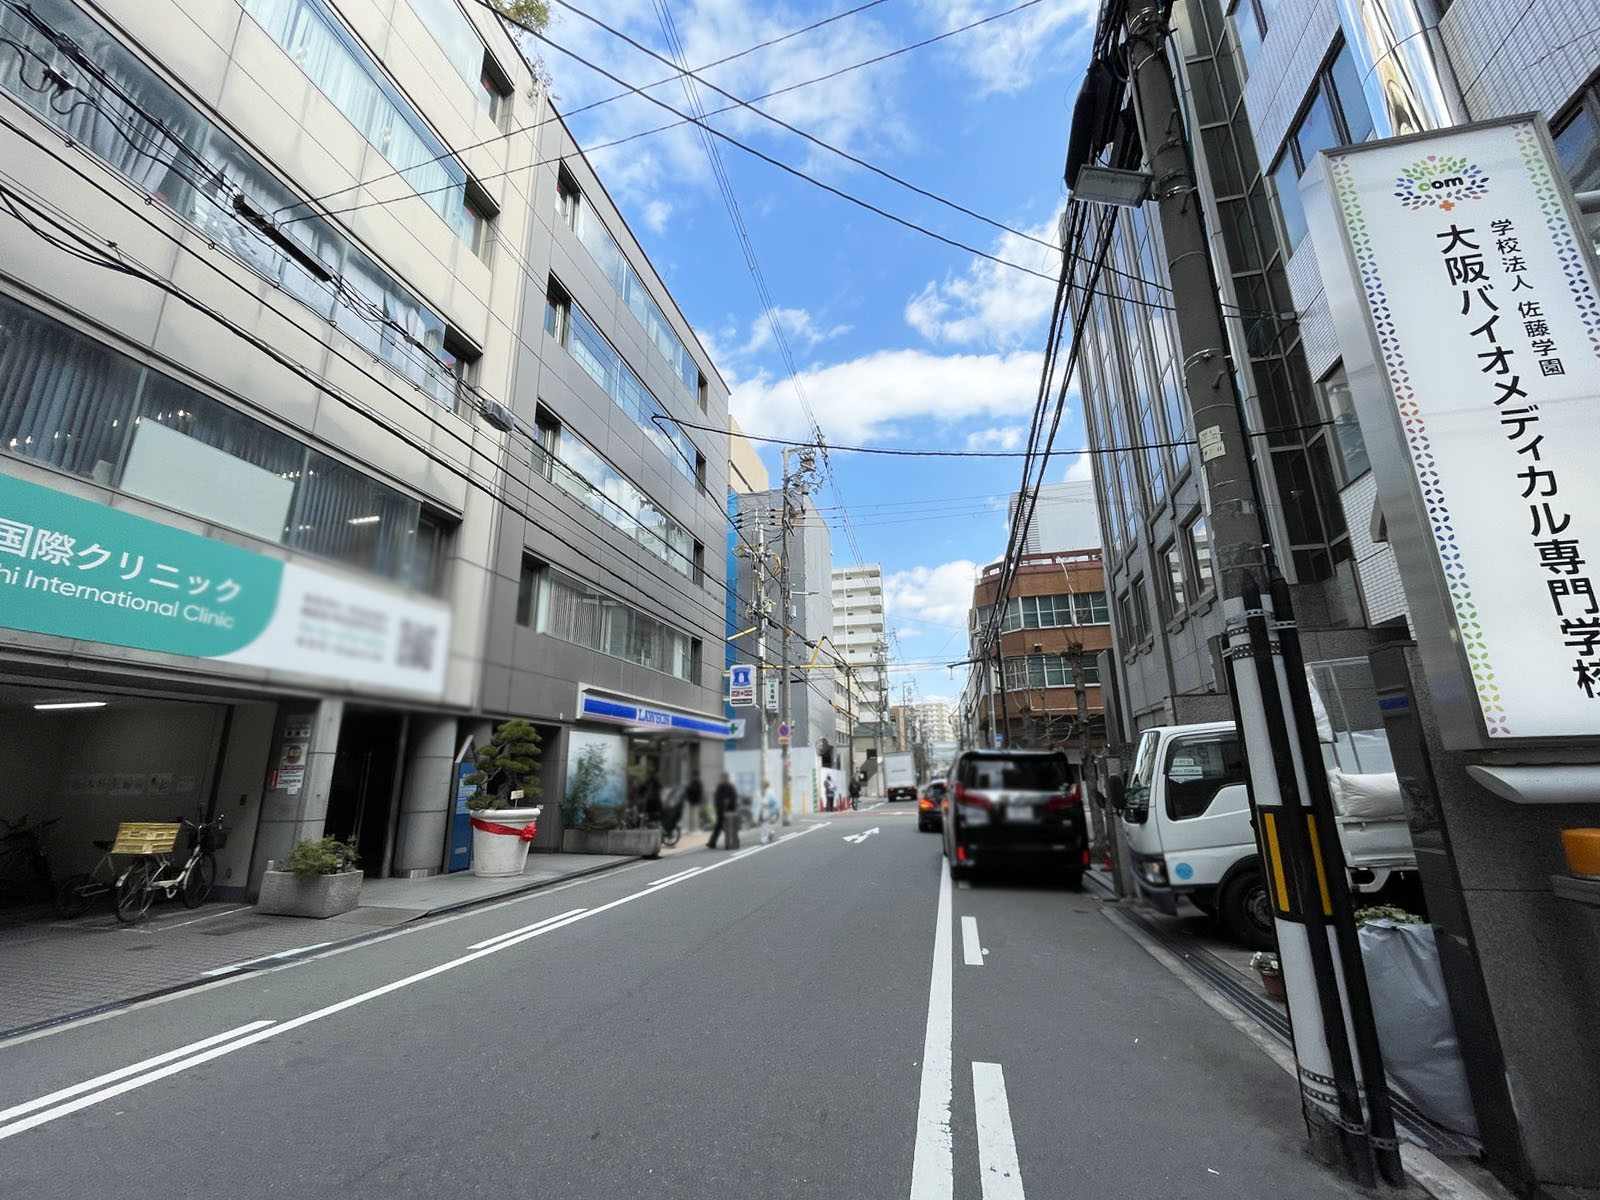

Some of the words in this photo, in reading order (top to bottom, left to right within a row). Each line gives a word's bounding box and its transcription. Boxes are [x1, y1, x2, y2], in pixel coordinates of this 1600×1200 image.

[1490, 219, 1534, 292] 学校法人
[1517, 300, 1566, 377] 佐藤学園
[0, 517, 242, 603] 国際クリニック
[25, 570, 179, 617] International
[183, 604, 235, 629] Clinic
[638, 708, 671, 726] LAWSON
